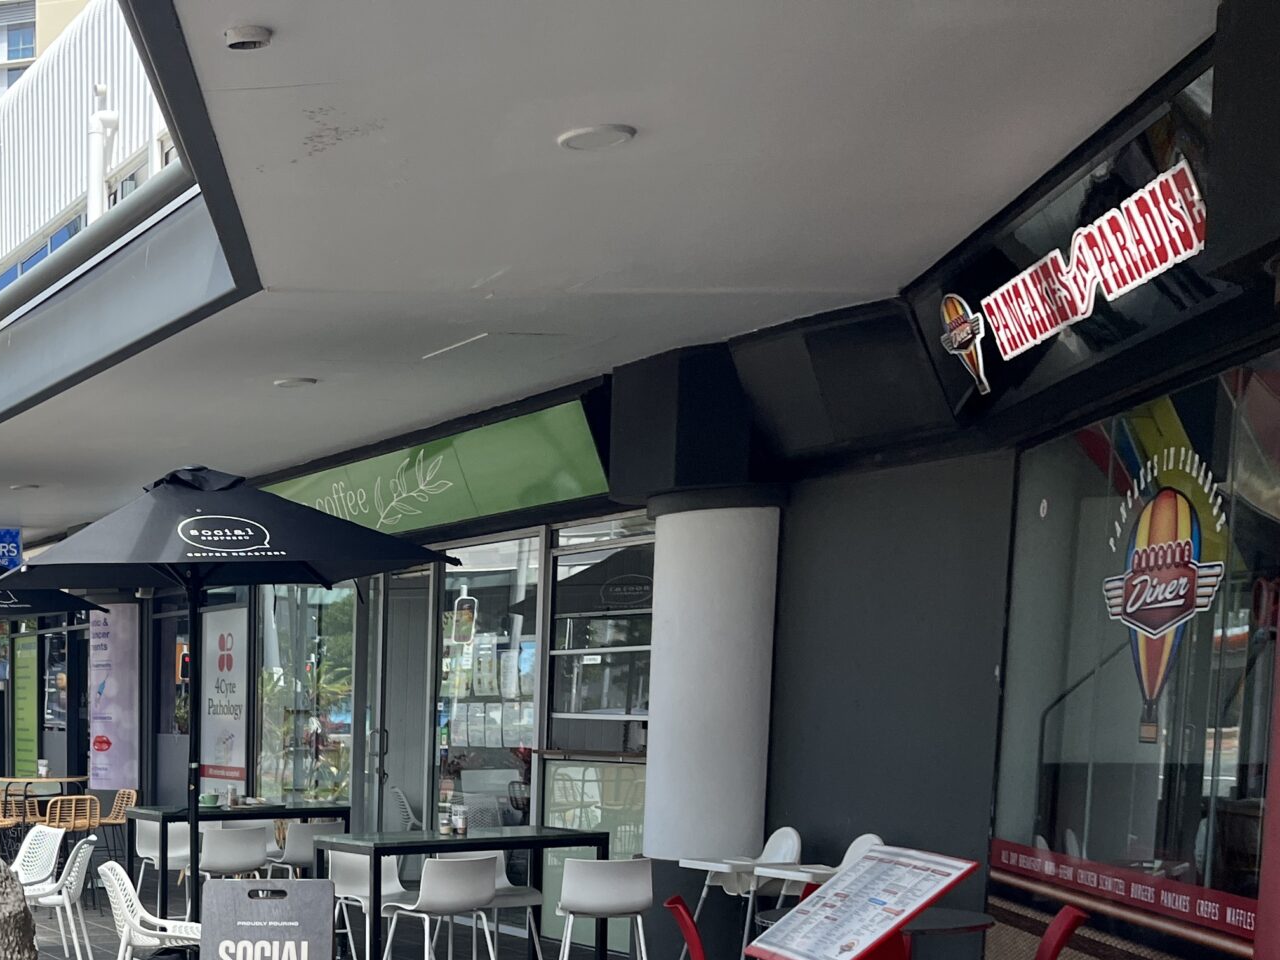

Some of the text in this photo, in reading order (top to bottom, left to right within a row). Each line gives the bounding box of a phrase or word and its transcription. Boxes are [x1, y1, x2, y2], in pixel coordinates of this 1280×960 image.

[984, 167, 1206, 356] PANCAKES IN PARADISE
[316, 481, 369, 521] coffee
[1109, 446, 1226, 552] PANCAKES IN PARADISE
[189, 528, 255, 536] social
[1133, 542, 1192, 571] PANCAKE
[1126, 575, 1190, 614] Diner
[214, 676, 237, 698] 4Cyte
[207, 698, 244, 721] Pathology
[1130, 882, 1156, 903] BURGERS
[1160, 890, 1190, 913] PANCAKES
[1196, 899, 1220, 920] CREPES
[1226, 906, 1256, 931] WAFFLES
[236, 920, 267, 928] PROUDLY
